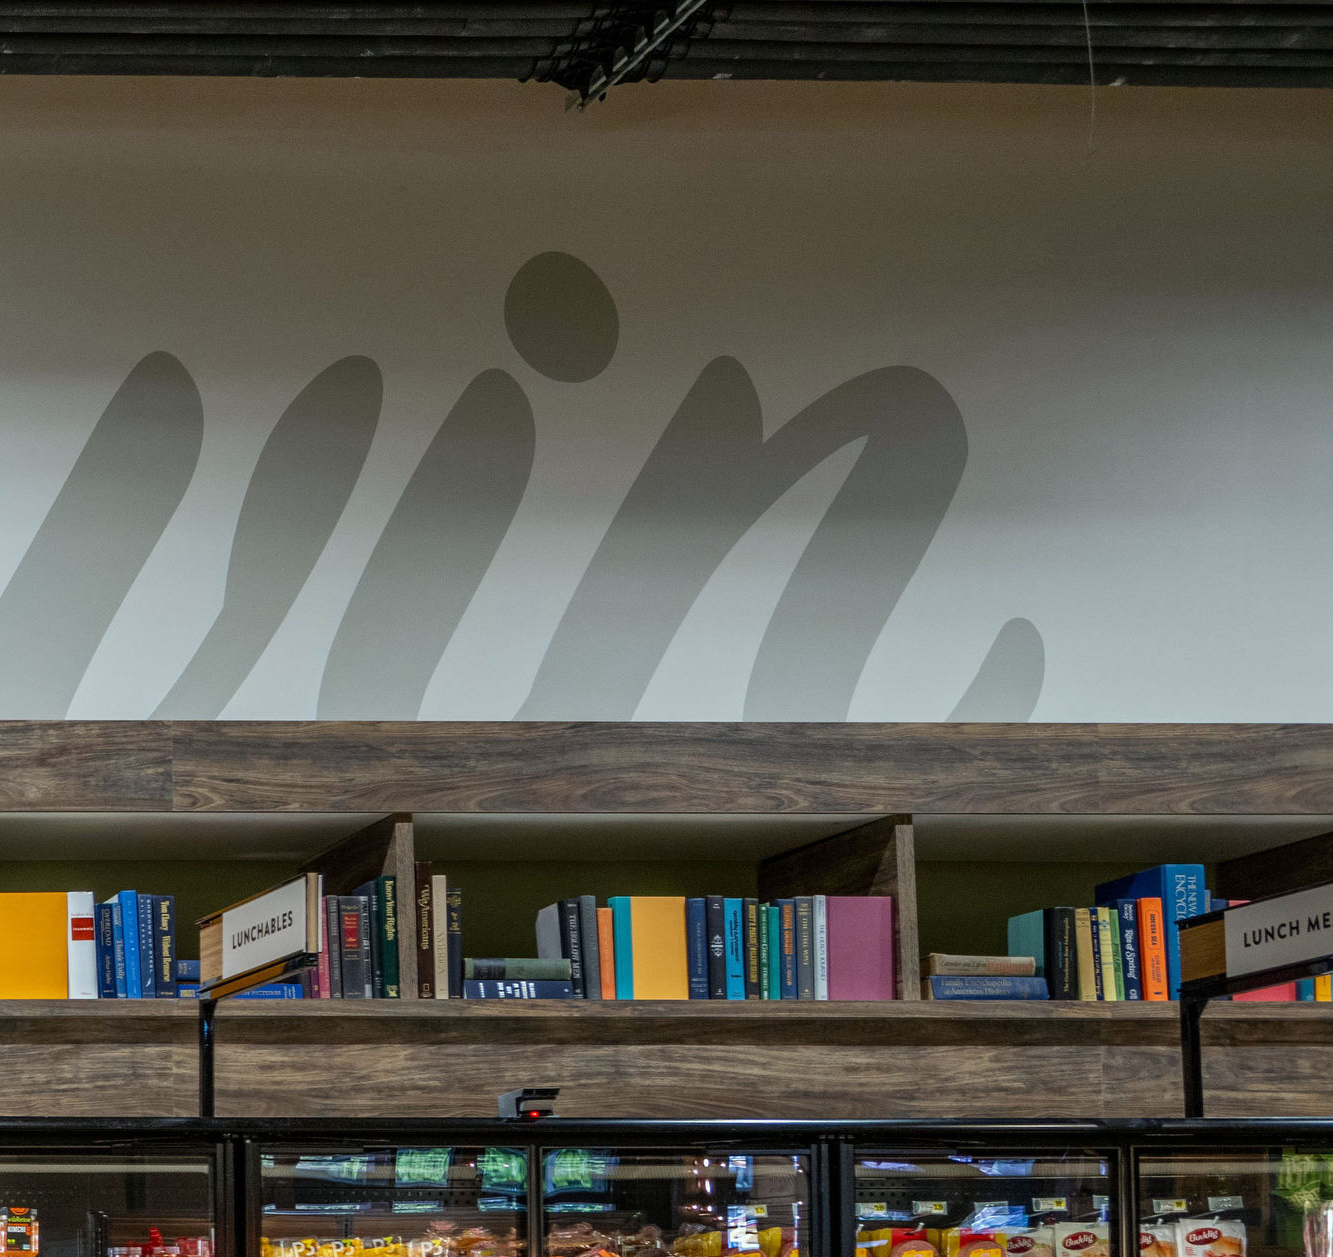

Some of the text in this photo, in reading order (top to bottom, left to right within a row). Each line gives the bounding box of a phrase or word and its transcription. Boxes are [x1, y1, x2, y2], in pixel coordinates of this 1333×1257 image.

[1188, 875, 1196, 910] THE NEW
[385, 880, 395, 940] Know Your Rights
[160, 901, 171, 982] Tom Clancy Without Remorse
[231, 910, 294, 950] LUNCHABLES
[569, 914, 580, 978] THE HOLLOW MEN
[1125, 929, 1134, 943] Rite
[1243, 920, 1301, 949] LUNCH
[1126, 952, 1136, 979] Spring
[1065, 1235, 1094, 1247] Buddig
[1189, 1230, 1219, 1242] Buddig
